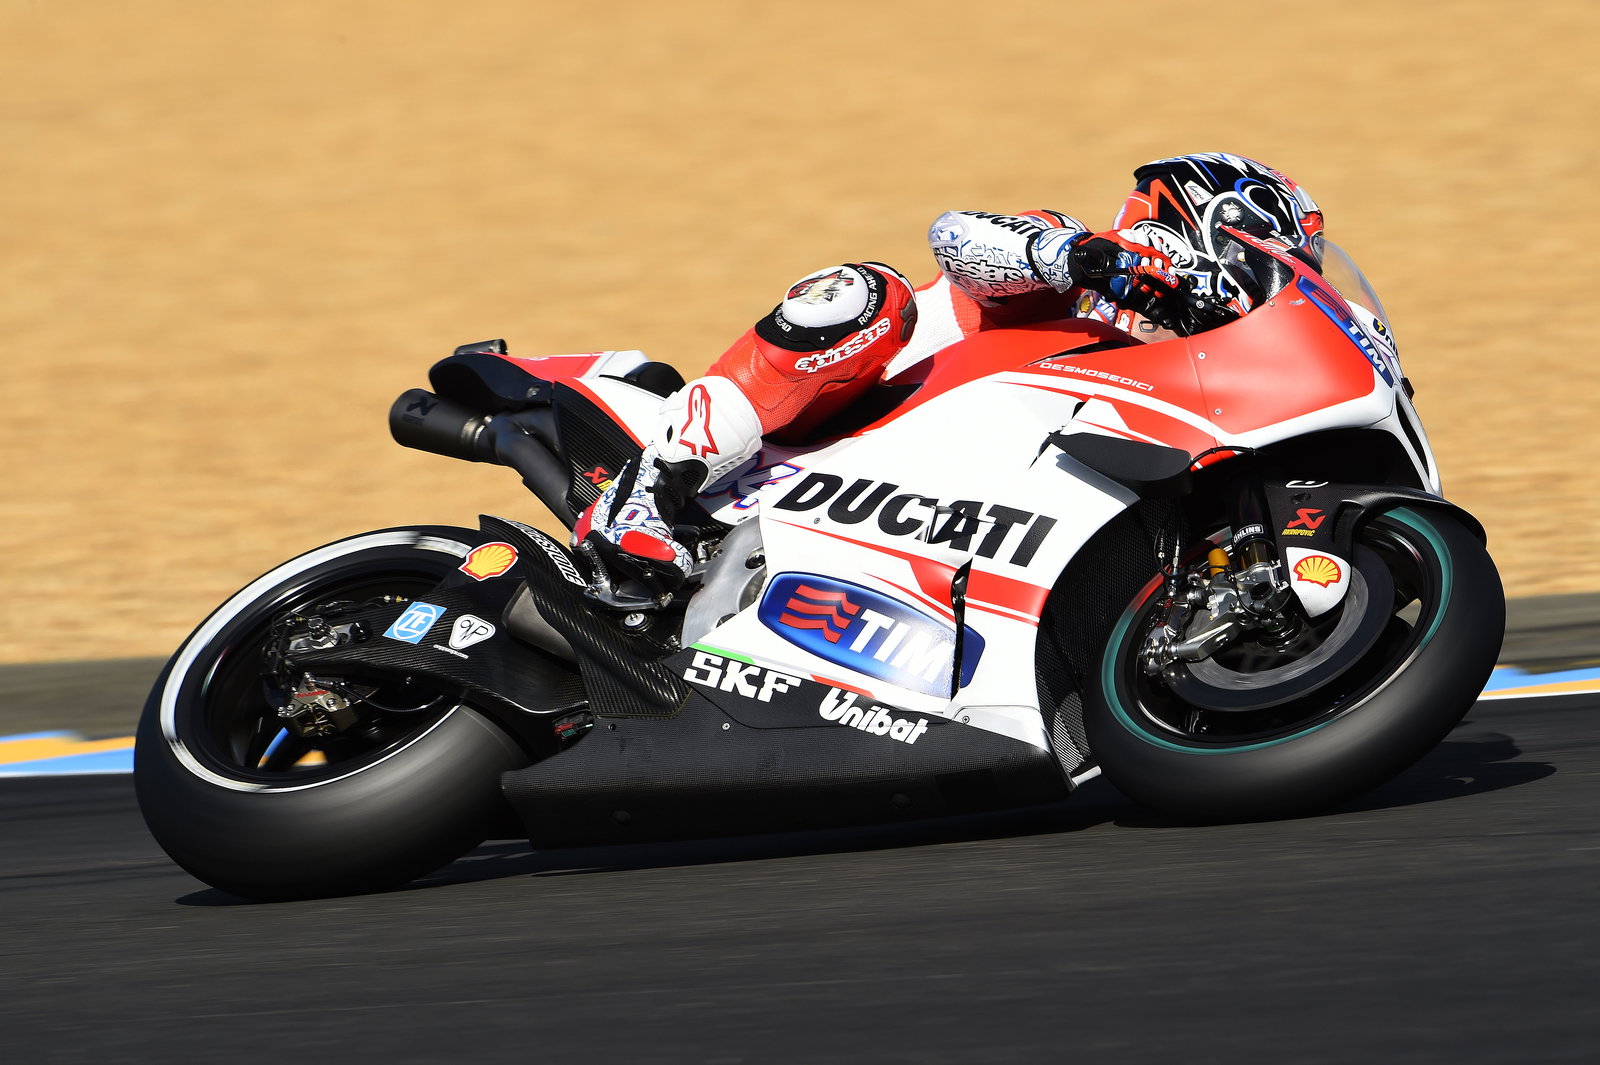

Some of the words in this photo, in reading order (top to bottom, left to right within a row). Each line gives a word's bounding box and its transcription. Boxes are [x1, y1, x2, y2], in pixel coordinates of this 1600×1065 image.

[859, 292, 877, 325] RACING
[1348, 320, 1386, 372] TIM
[1039, 362, 1154, 391] DESMOSEDICI
[772, 472, 1058, 568] DUCATI
[848, 608, 956, 683] TIM
[682, 651, 802, 703] SKF
[819, 687, 929, 745] Unibat
